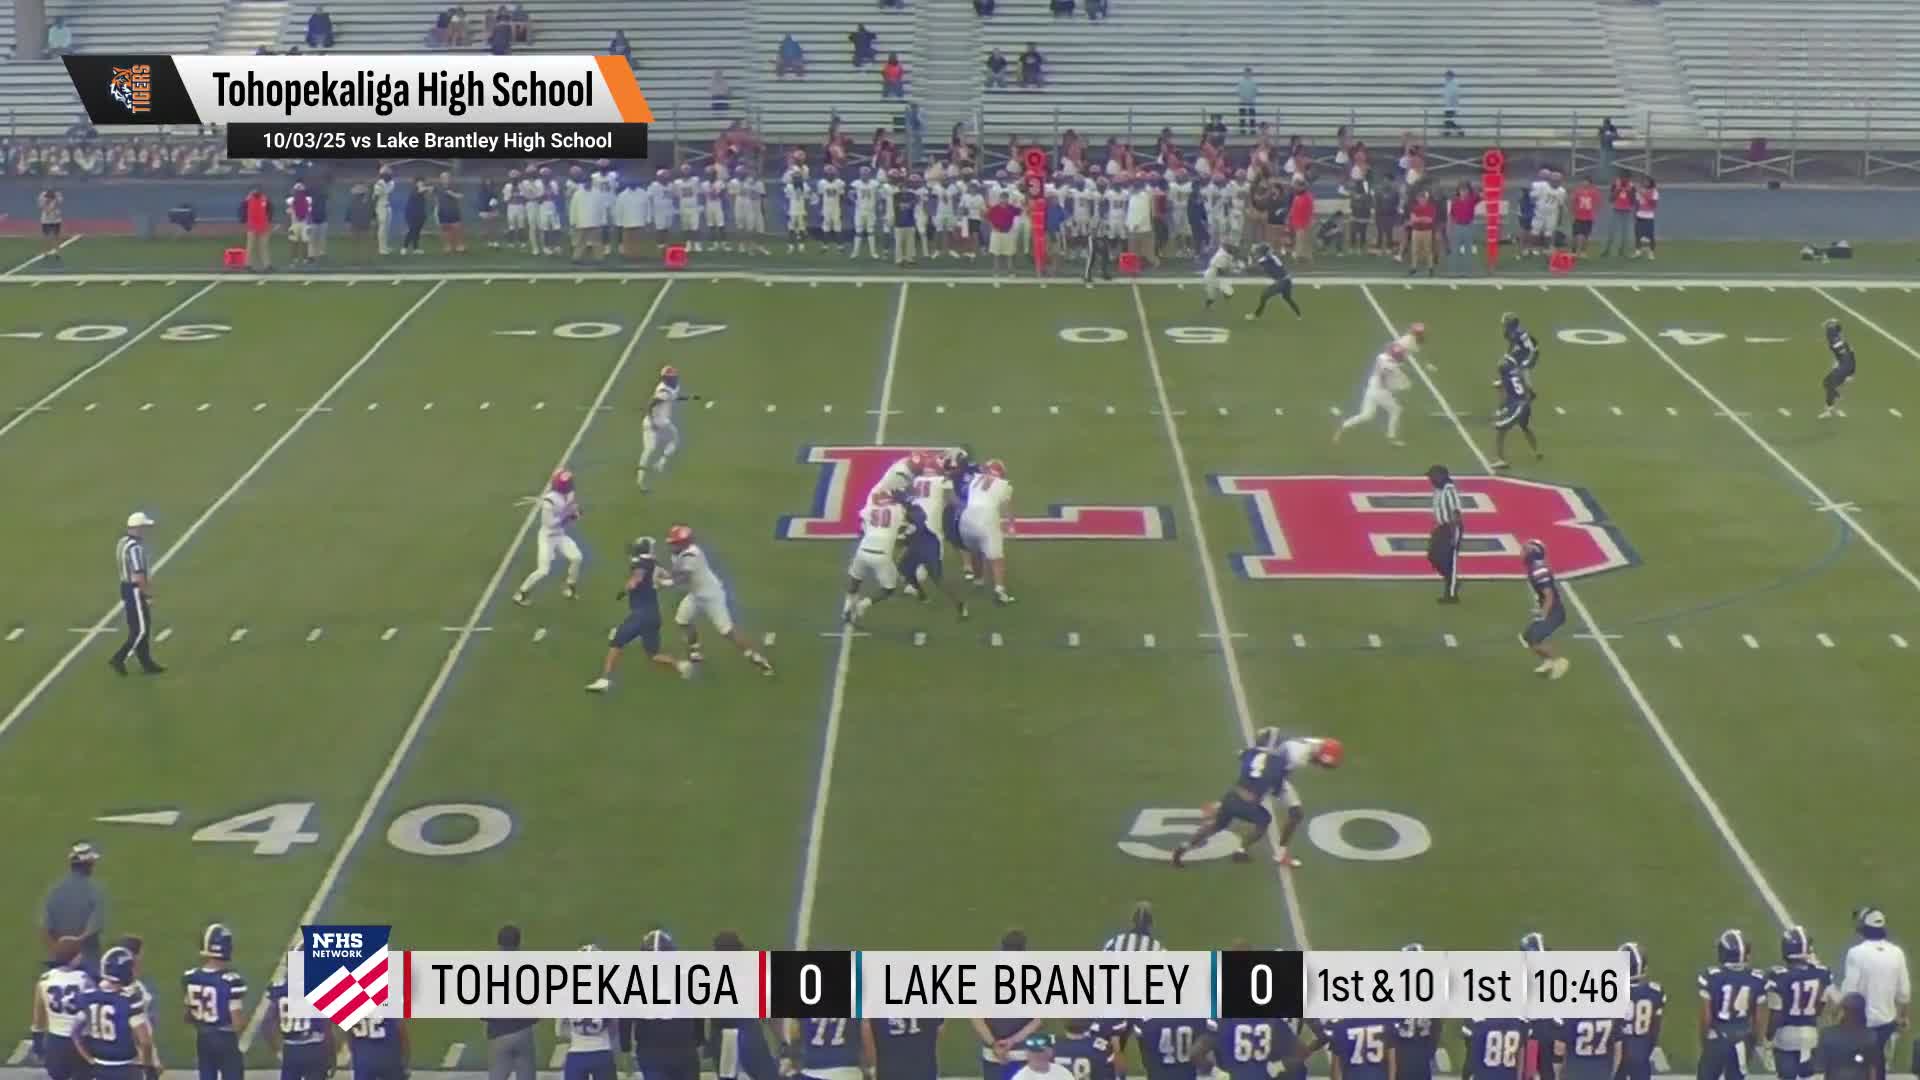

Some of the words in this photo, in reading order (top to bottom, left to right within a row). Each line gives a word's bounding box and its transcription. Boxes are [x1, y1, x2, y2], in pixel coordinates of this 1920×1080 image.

[187, 984, 219, 1023] 53
[1718, 984, 1750, 1020] 14
[1789, 979, 1820, 1016] 17
[88, 1003, 117, 1041] 16
[1575, 1020, 1613, 1056] 27
[1159, 1026, 1193, 1064] 40
[1234, 1024, 1273, 1062] 63
[1347, 1025, 1385, 1064] 75
[1483, 1030, 1520, 1068] 88
